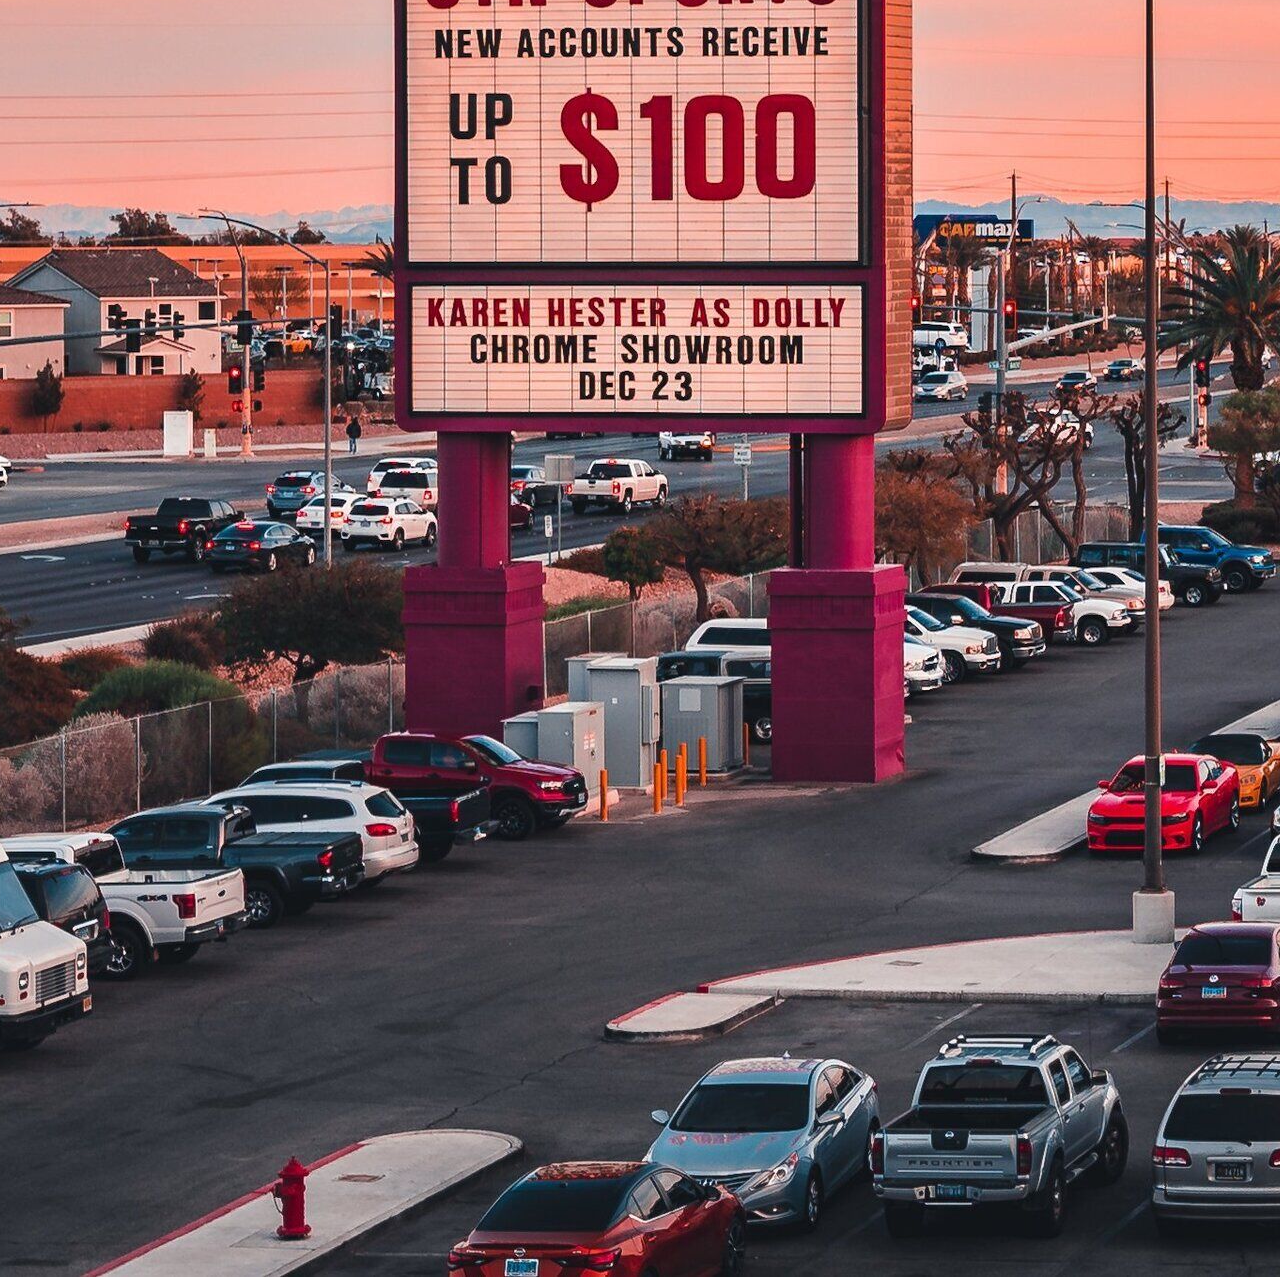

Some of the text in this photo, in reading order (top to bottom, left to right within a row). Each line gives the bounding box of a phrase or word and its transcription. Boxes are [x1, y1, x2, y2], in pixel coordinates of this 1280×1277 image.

[434, 25, 829, 59] NEW ACCOUNTS RECEIVE
[449, 86, 817, 213] UP $100
[449, 155, 512, 206] TO
[427, 295, 846, 329] KAREN HESTER AS DOLLY
[470, 333, 803, 366] CHROME SHOWROOM
[579, 370, 693, 402] DEC 23
[907, 1159, 994, 1167] FRONTIER
